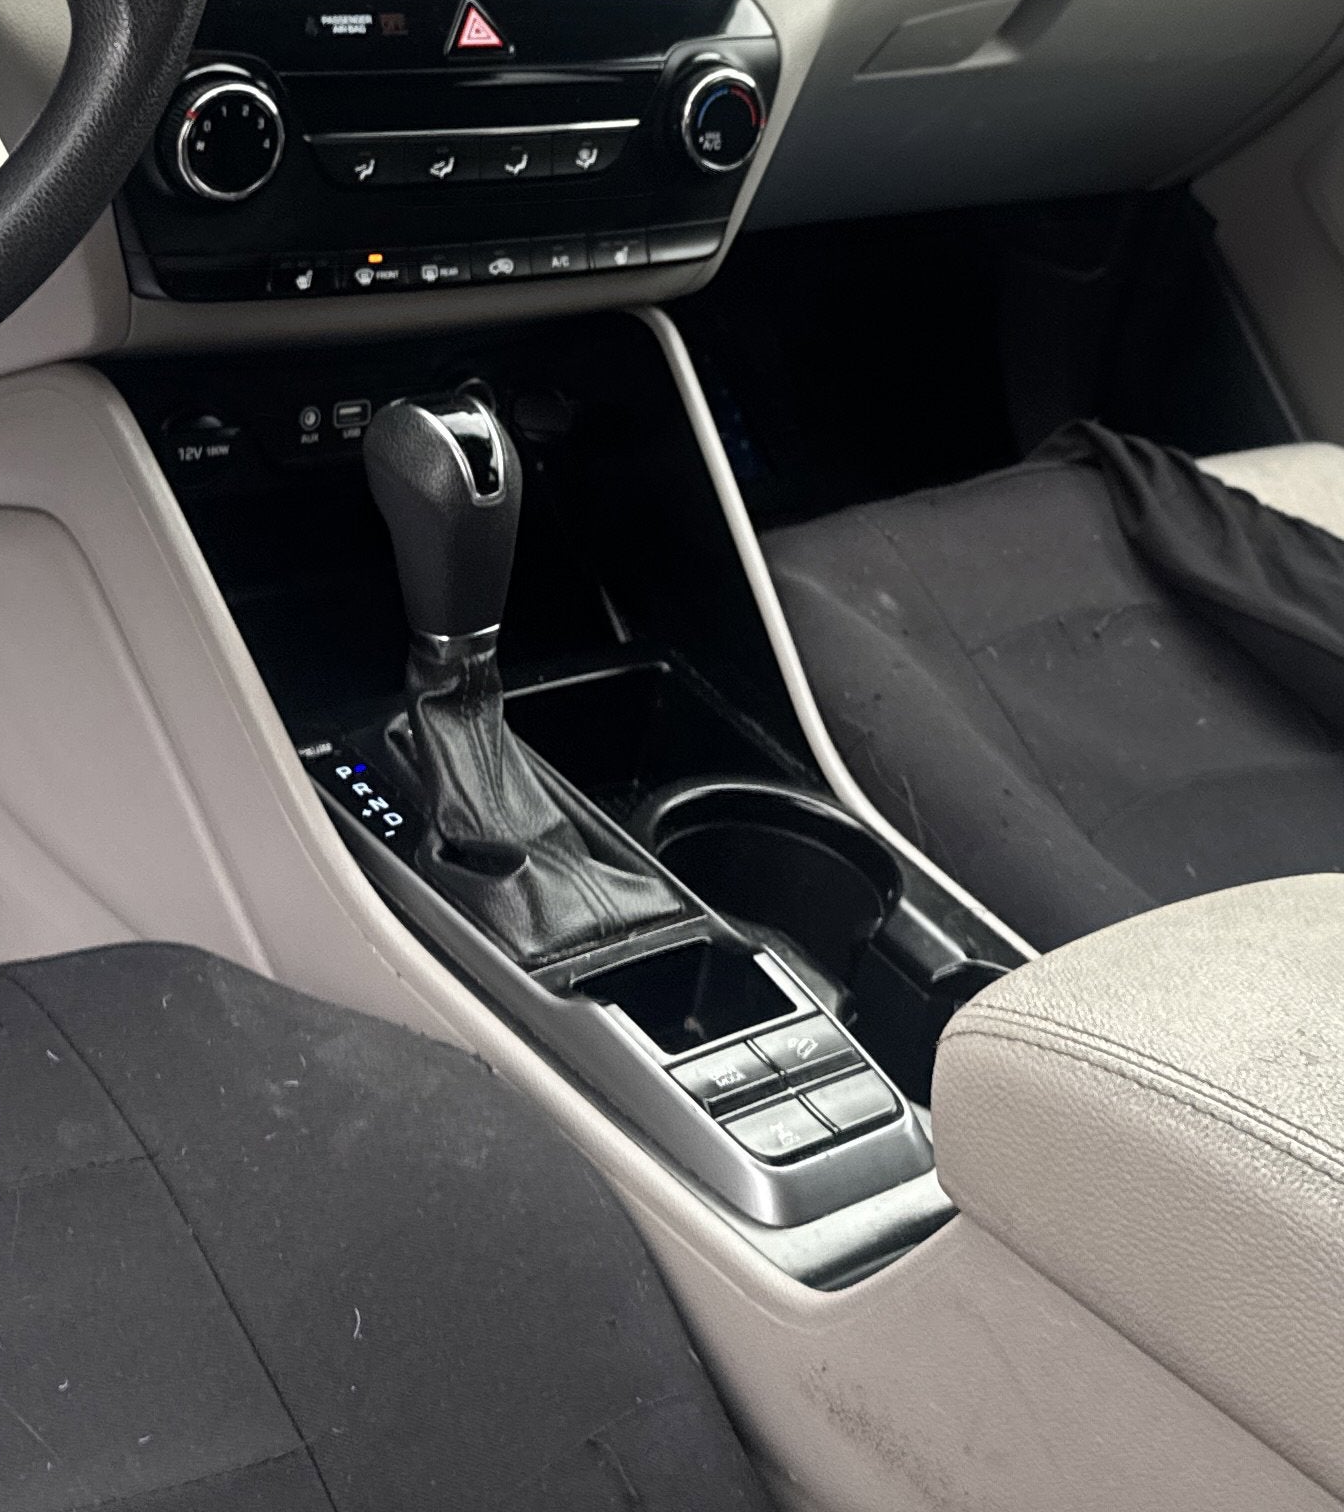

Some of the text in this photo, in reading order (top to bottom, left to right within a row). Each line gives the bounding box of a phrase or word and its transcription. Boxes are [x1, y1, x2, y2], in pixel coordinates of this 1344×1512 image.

[551, 254, 571, 269] A/C
[177, 445, 204, 461] 12V
[335, 765, 353, 781] P
[351, 781, 374, 797] R
[382, 811, 405, 827] D
